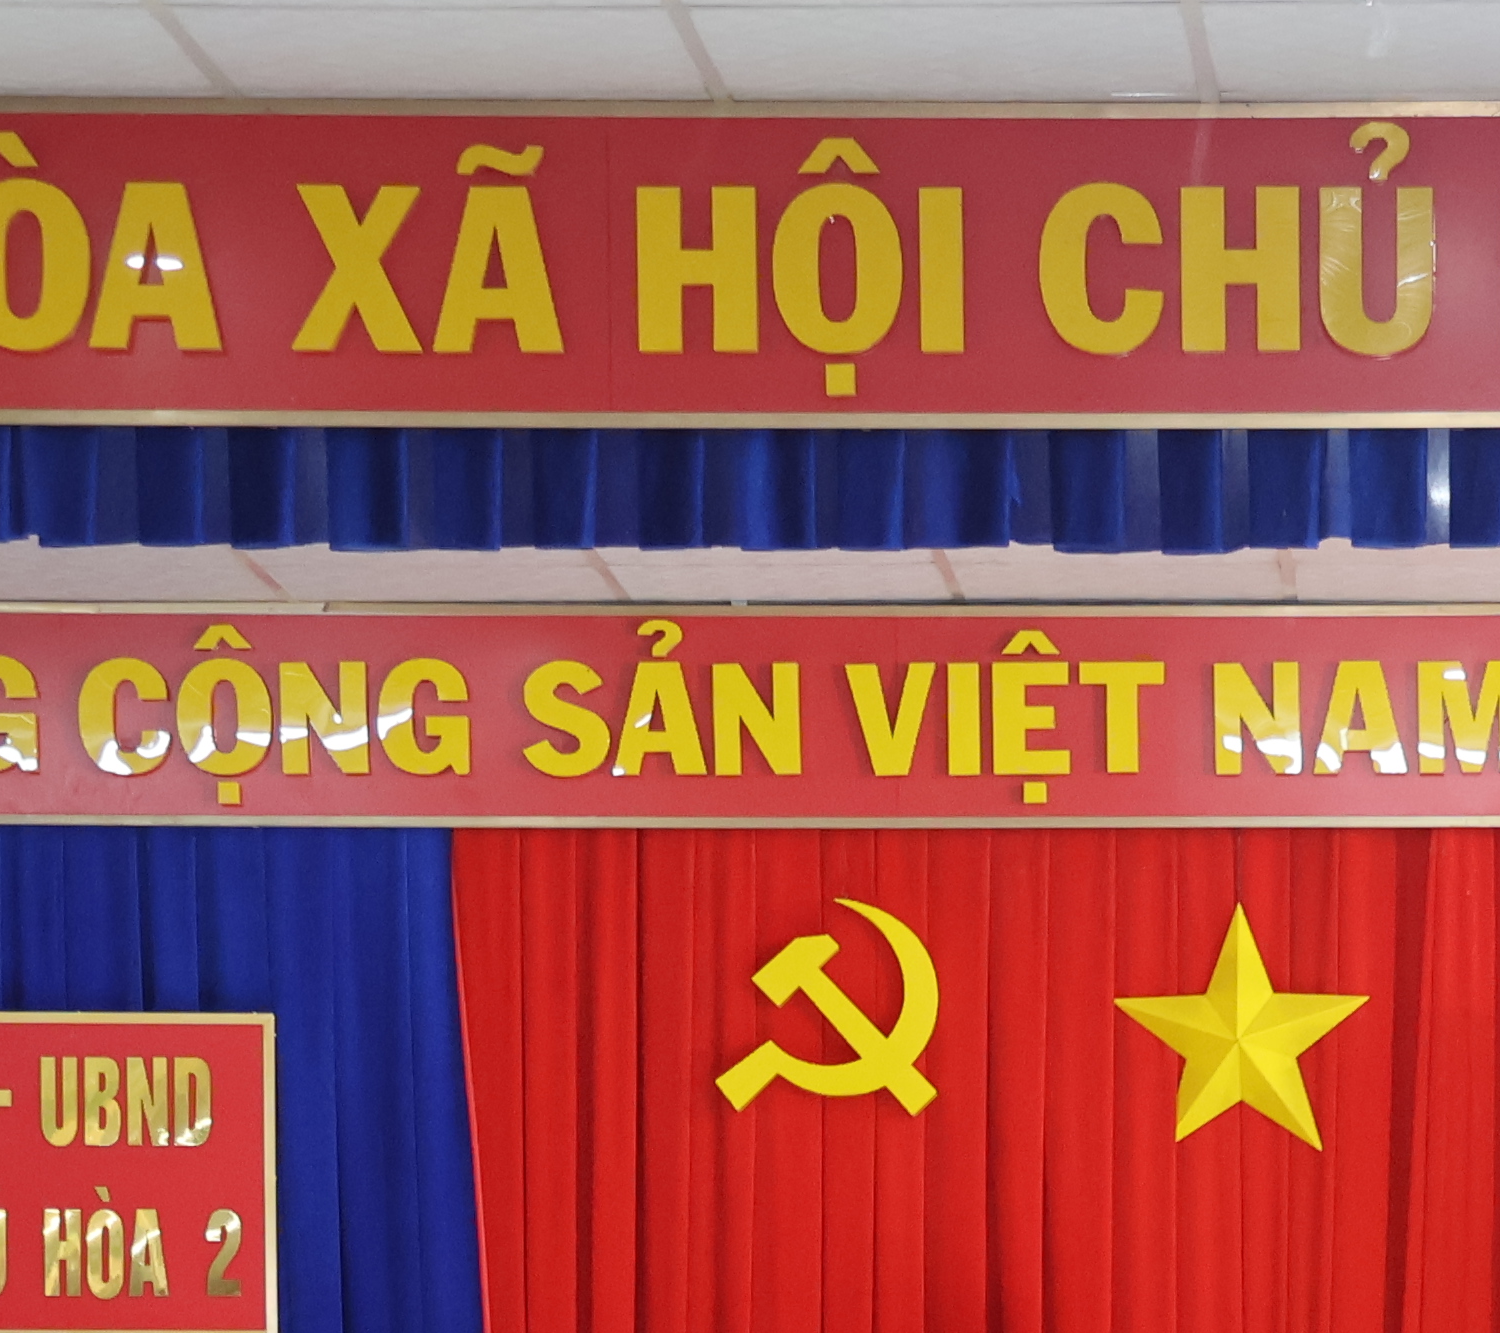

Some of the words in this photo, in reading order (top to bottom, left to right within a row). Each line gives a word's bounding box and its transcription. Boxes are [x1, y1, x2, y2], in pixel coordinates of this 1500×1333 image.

[291, 143, 565, 354] XÃ
[636, 137, 966, 397] HỘI
[1038, 121, 1433, 356] CHỦ
[77, 622, 472, 806] CỘNG
[521, 618, 803, 779] SẢN
[844, 628, 1167, 805] VIỆT
[39, 1055, 214, 1148] UBND
[43, 1185, 170, 1300] HÒA
[205, 1207, 243, 1297] 2
